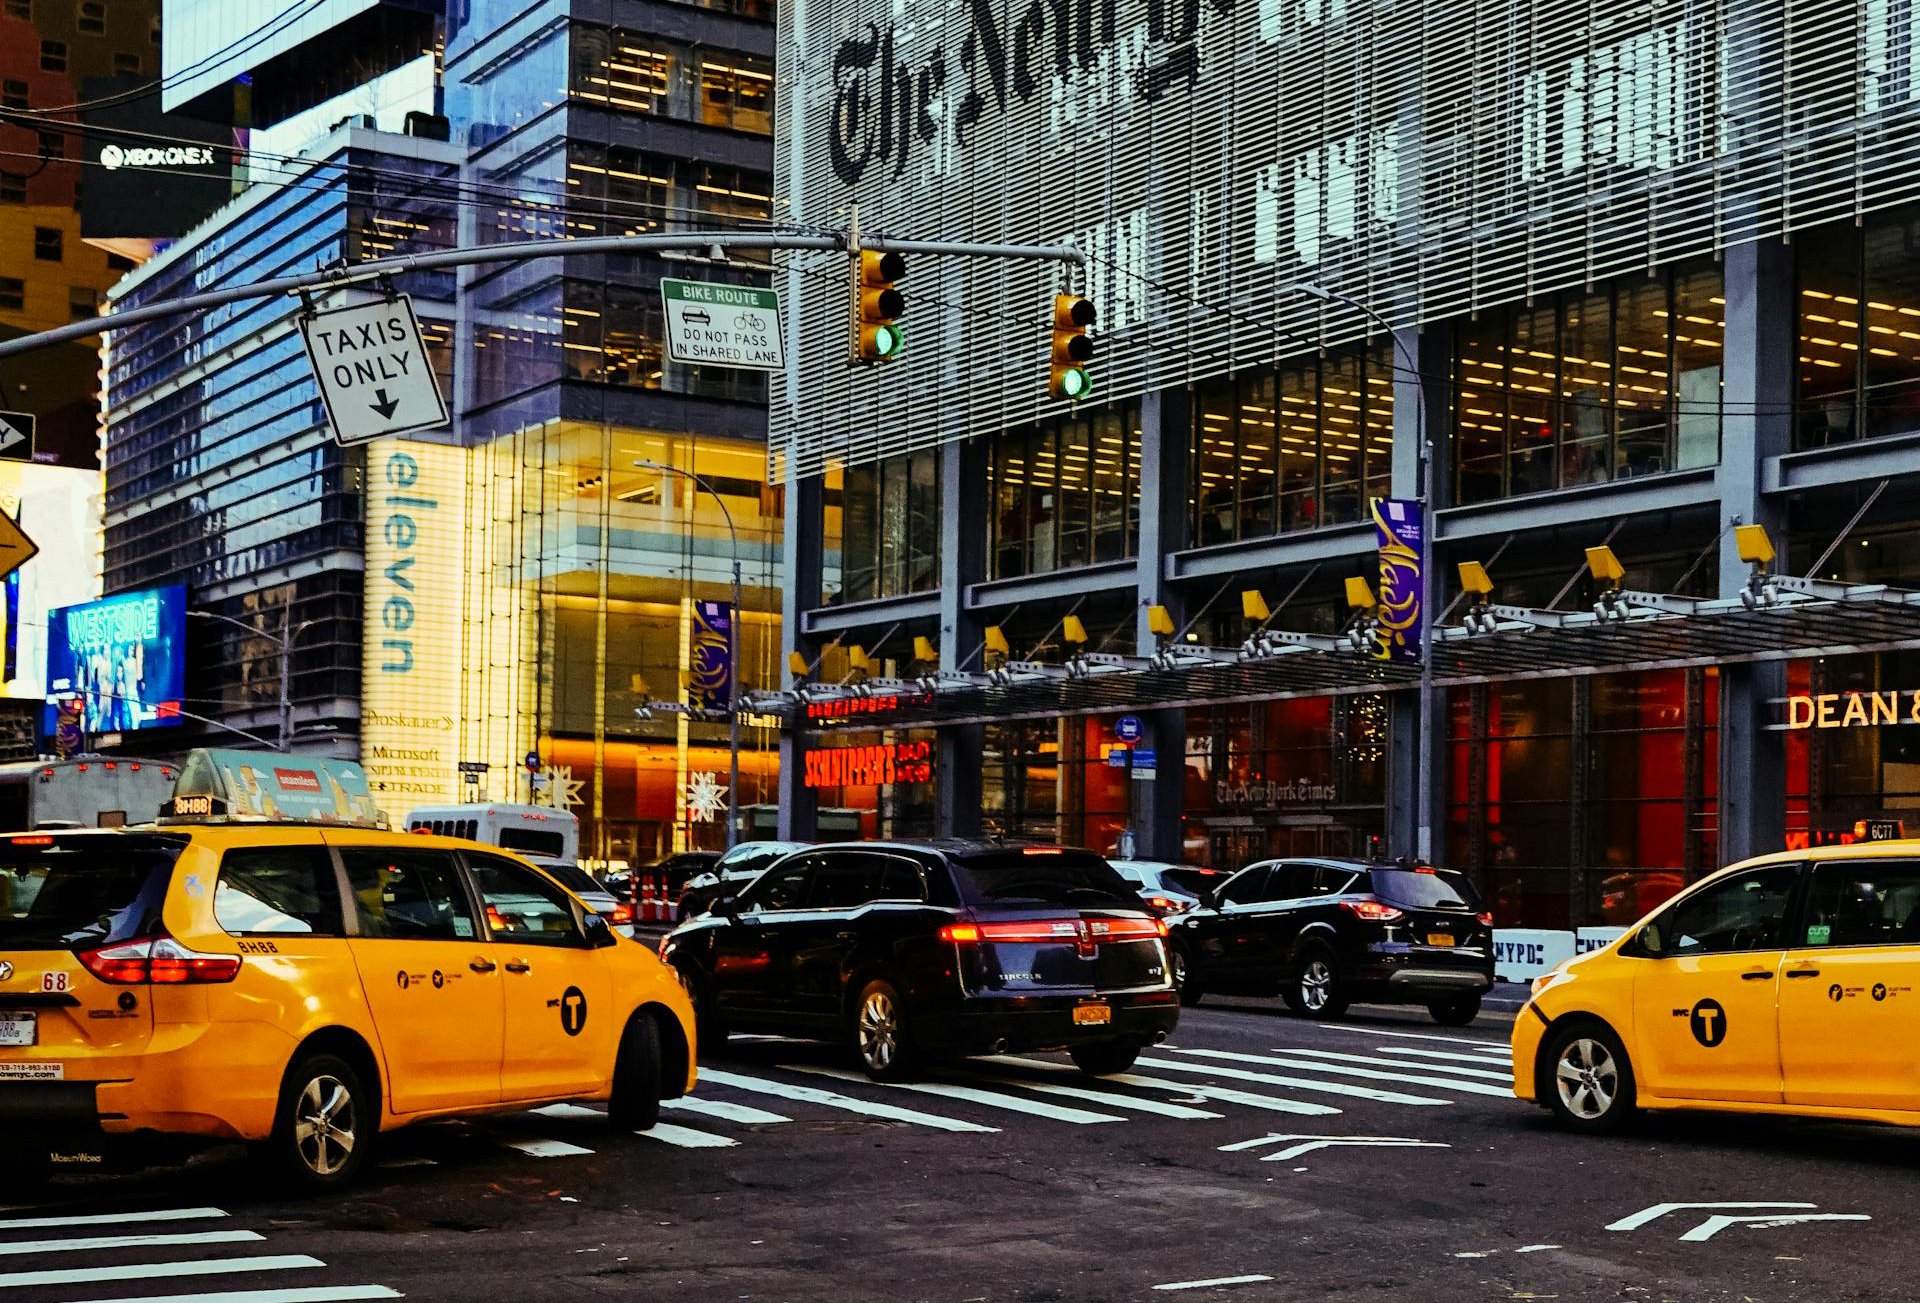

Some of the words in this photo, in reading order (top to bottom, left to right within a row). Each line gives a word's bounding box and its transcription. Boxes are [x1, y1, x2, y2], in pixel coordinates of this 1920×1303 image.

[829, 20, 948, 185] The
[123, 148, 167, 166] XBOX
[165, 147, 200, 165] ONE
[200, 146, 215, 165] X
[682, 286, 712, 300] BIKE
[716, 290, 759, 305] ROUTE
[316, 317, 407, 357] TAXIS
[684, 328, 701, 341] DO
[705, 331, 729, 343] NOT
[735, 333, 768, 347] PASS
[677, 343, 688, 355] IN
[693, 344, 741, 360] SHARED
[746, 350, 779, 363] LANE
[333, 350, 409, 389] ONLY
[381, 451, 438, 674] eleven
[67, 598, 158, 647] WESTSIDE
[1789, 690, 1899, 729] DEAN
[373, 746, 440, 762] Microsoft
[1298, 778, 1336, 801] Times
[176, 800, 208, 814] 8H88
[1872, 825, 1893, 840] 6C77
[237, 941, 279, 954] 8H88
[1494, 942, 1536, 964] NYPD
[44, 973, 66, 991] 68
[1673, 1008, 1690, 1017] NYC
